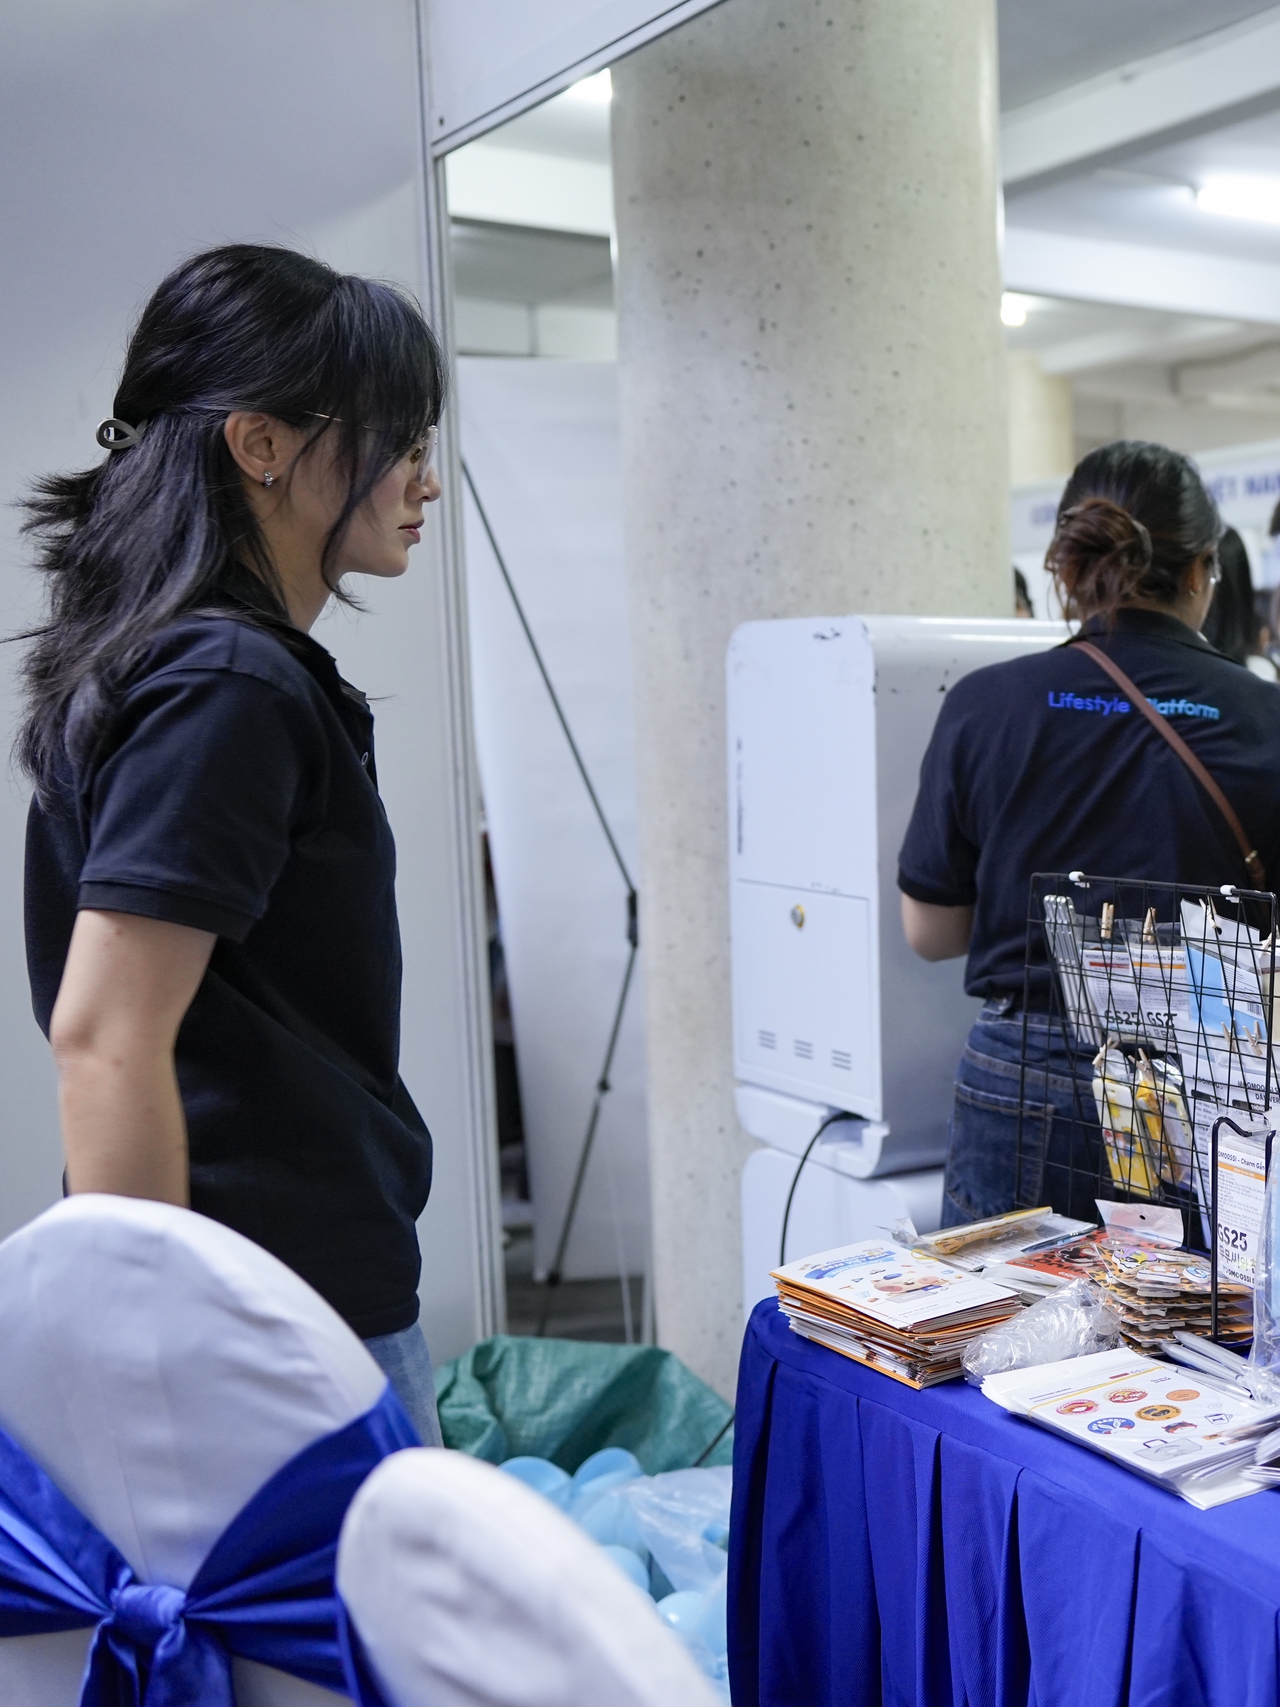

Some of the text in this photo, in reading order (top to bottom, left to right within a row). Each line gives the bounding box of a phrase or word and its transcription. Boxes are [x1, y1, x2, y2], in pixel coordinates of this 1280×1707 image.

[1048, 691, 1131, 717] Lifestyle
[1240, 1157, 1256, 1168] Charm
[1217, 1223, 1248, 1252] GS25
